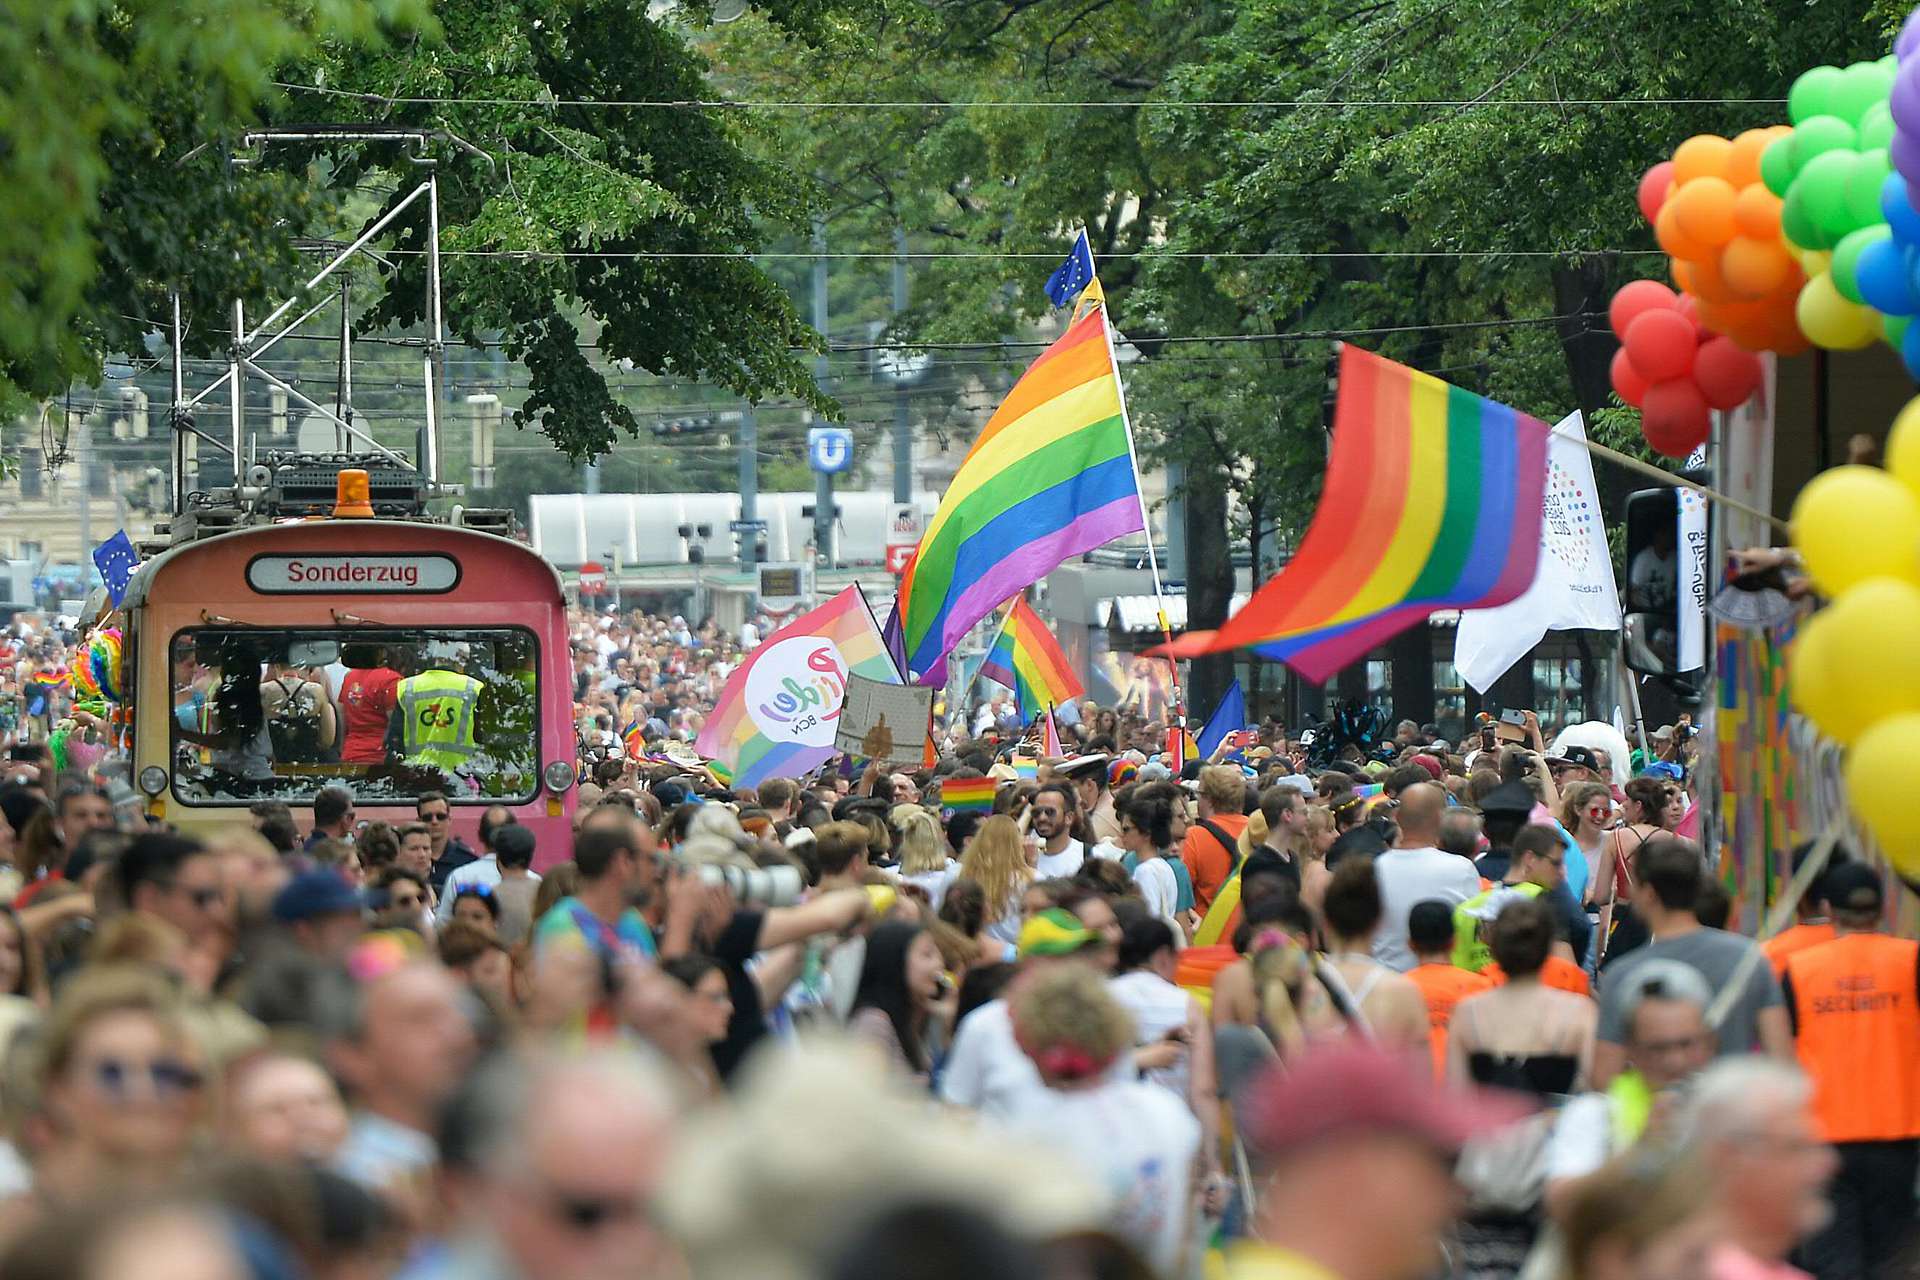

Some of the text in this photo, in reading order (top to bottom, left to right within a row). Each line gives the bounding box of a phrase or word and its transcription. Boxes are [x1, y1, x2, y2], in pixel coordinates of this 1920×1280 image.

[818, 438, 846, 467] U
[287, 562, 418, 586] Sonderzug
[1812, 992, 1901, 1014] SECURITY
